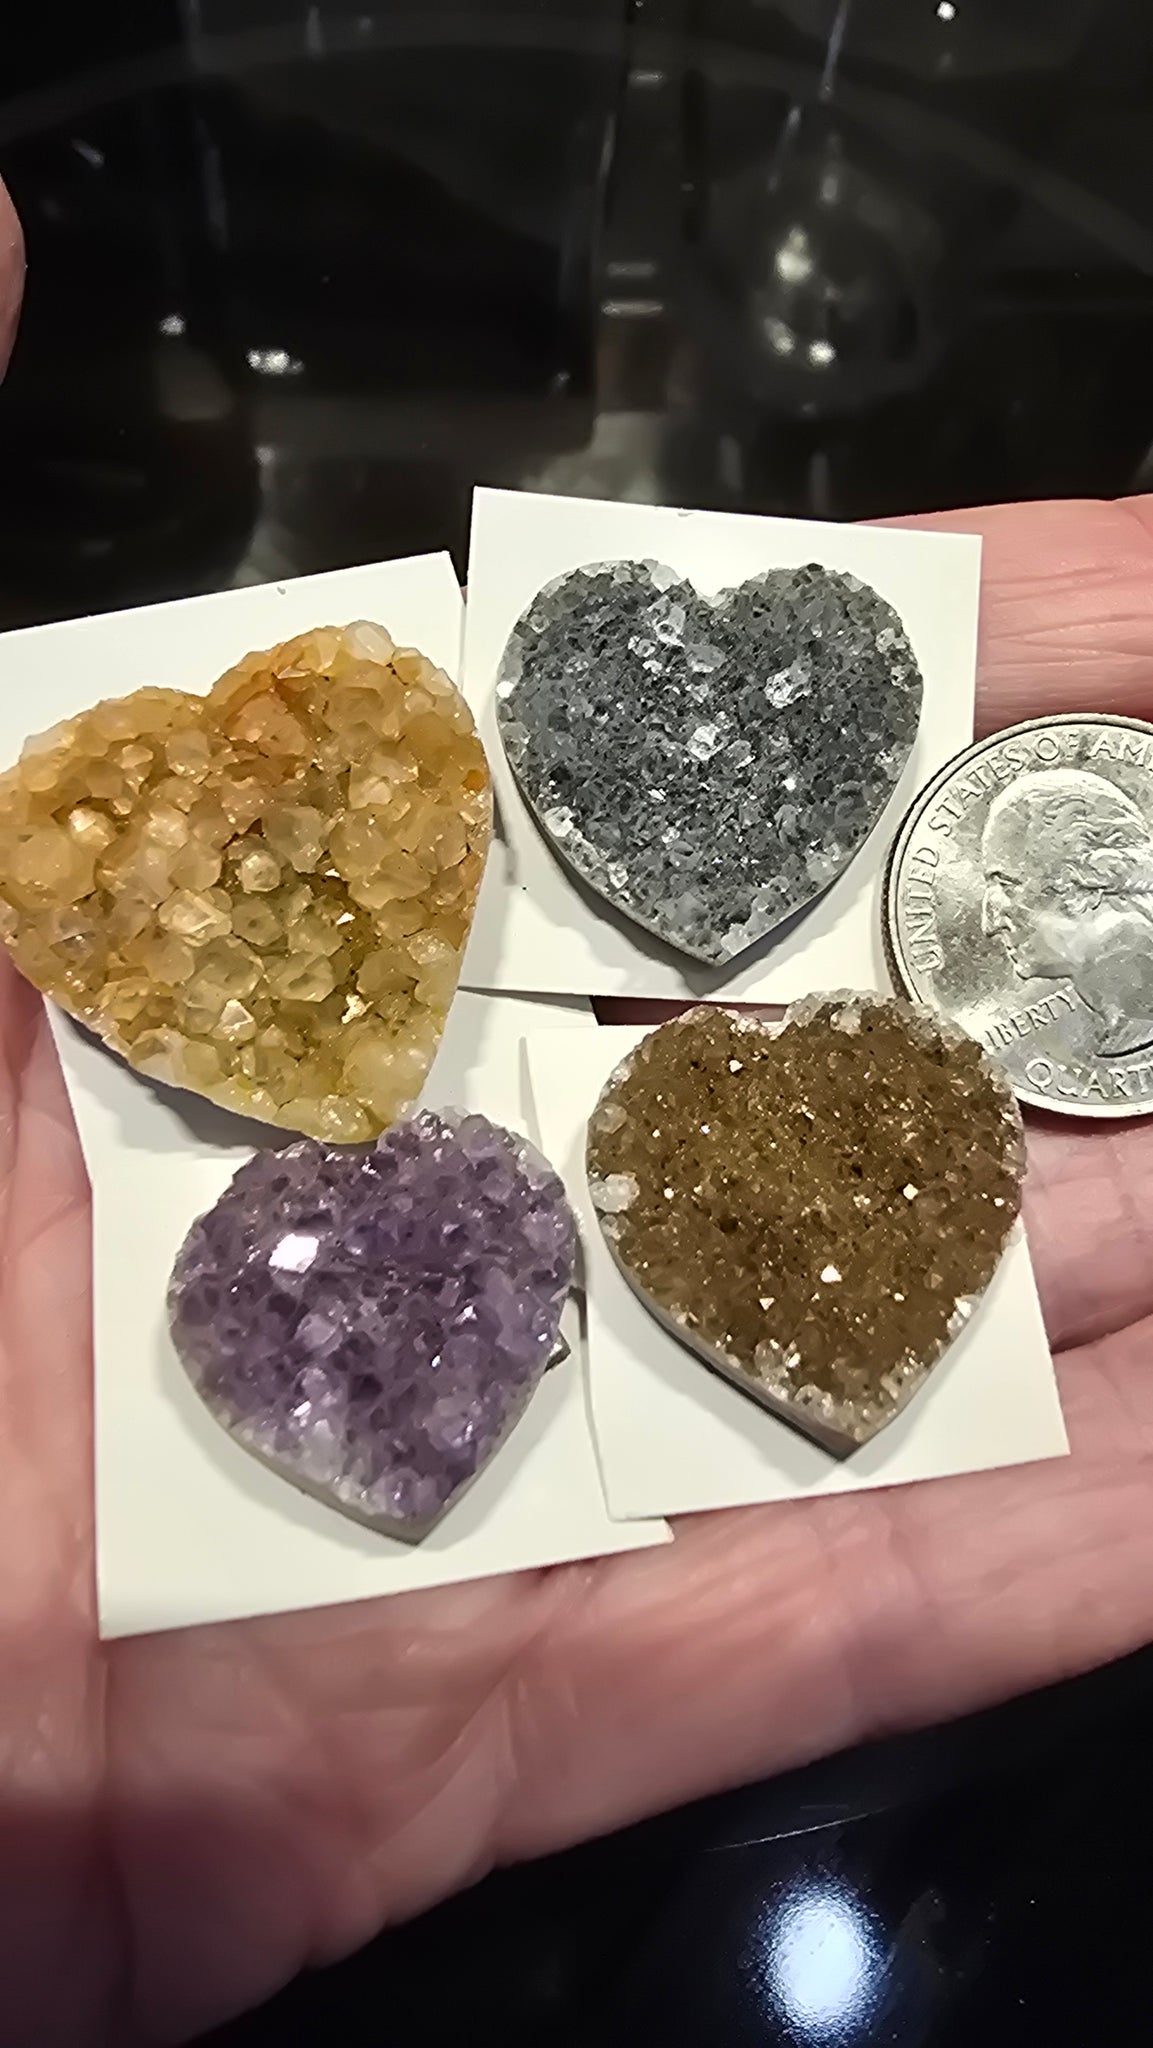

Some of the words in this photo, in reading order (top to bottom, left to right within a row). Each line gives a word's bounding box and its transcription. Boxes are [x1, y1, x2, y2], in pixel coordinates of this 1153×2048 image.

[905, 846, 943, 974] UNITED
[928, 743, 1026, 837] STATES
[1033, 730, 1080, 762] OF
[981, 985, 1077, 1050] IBERTY
[1025, 1058, 1153, 1099] QUART
